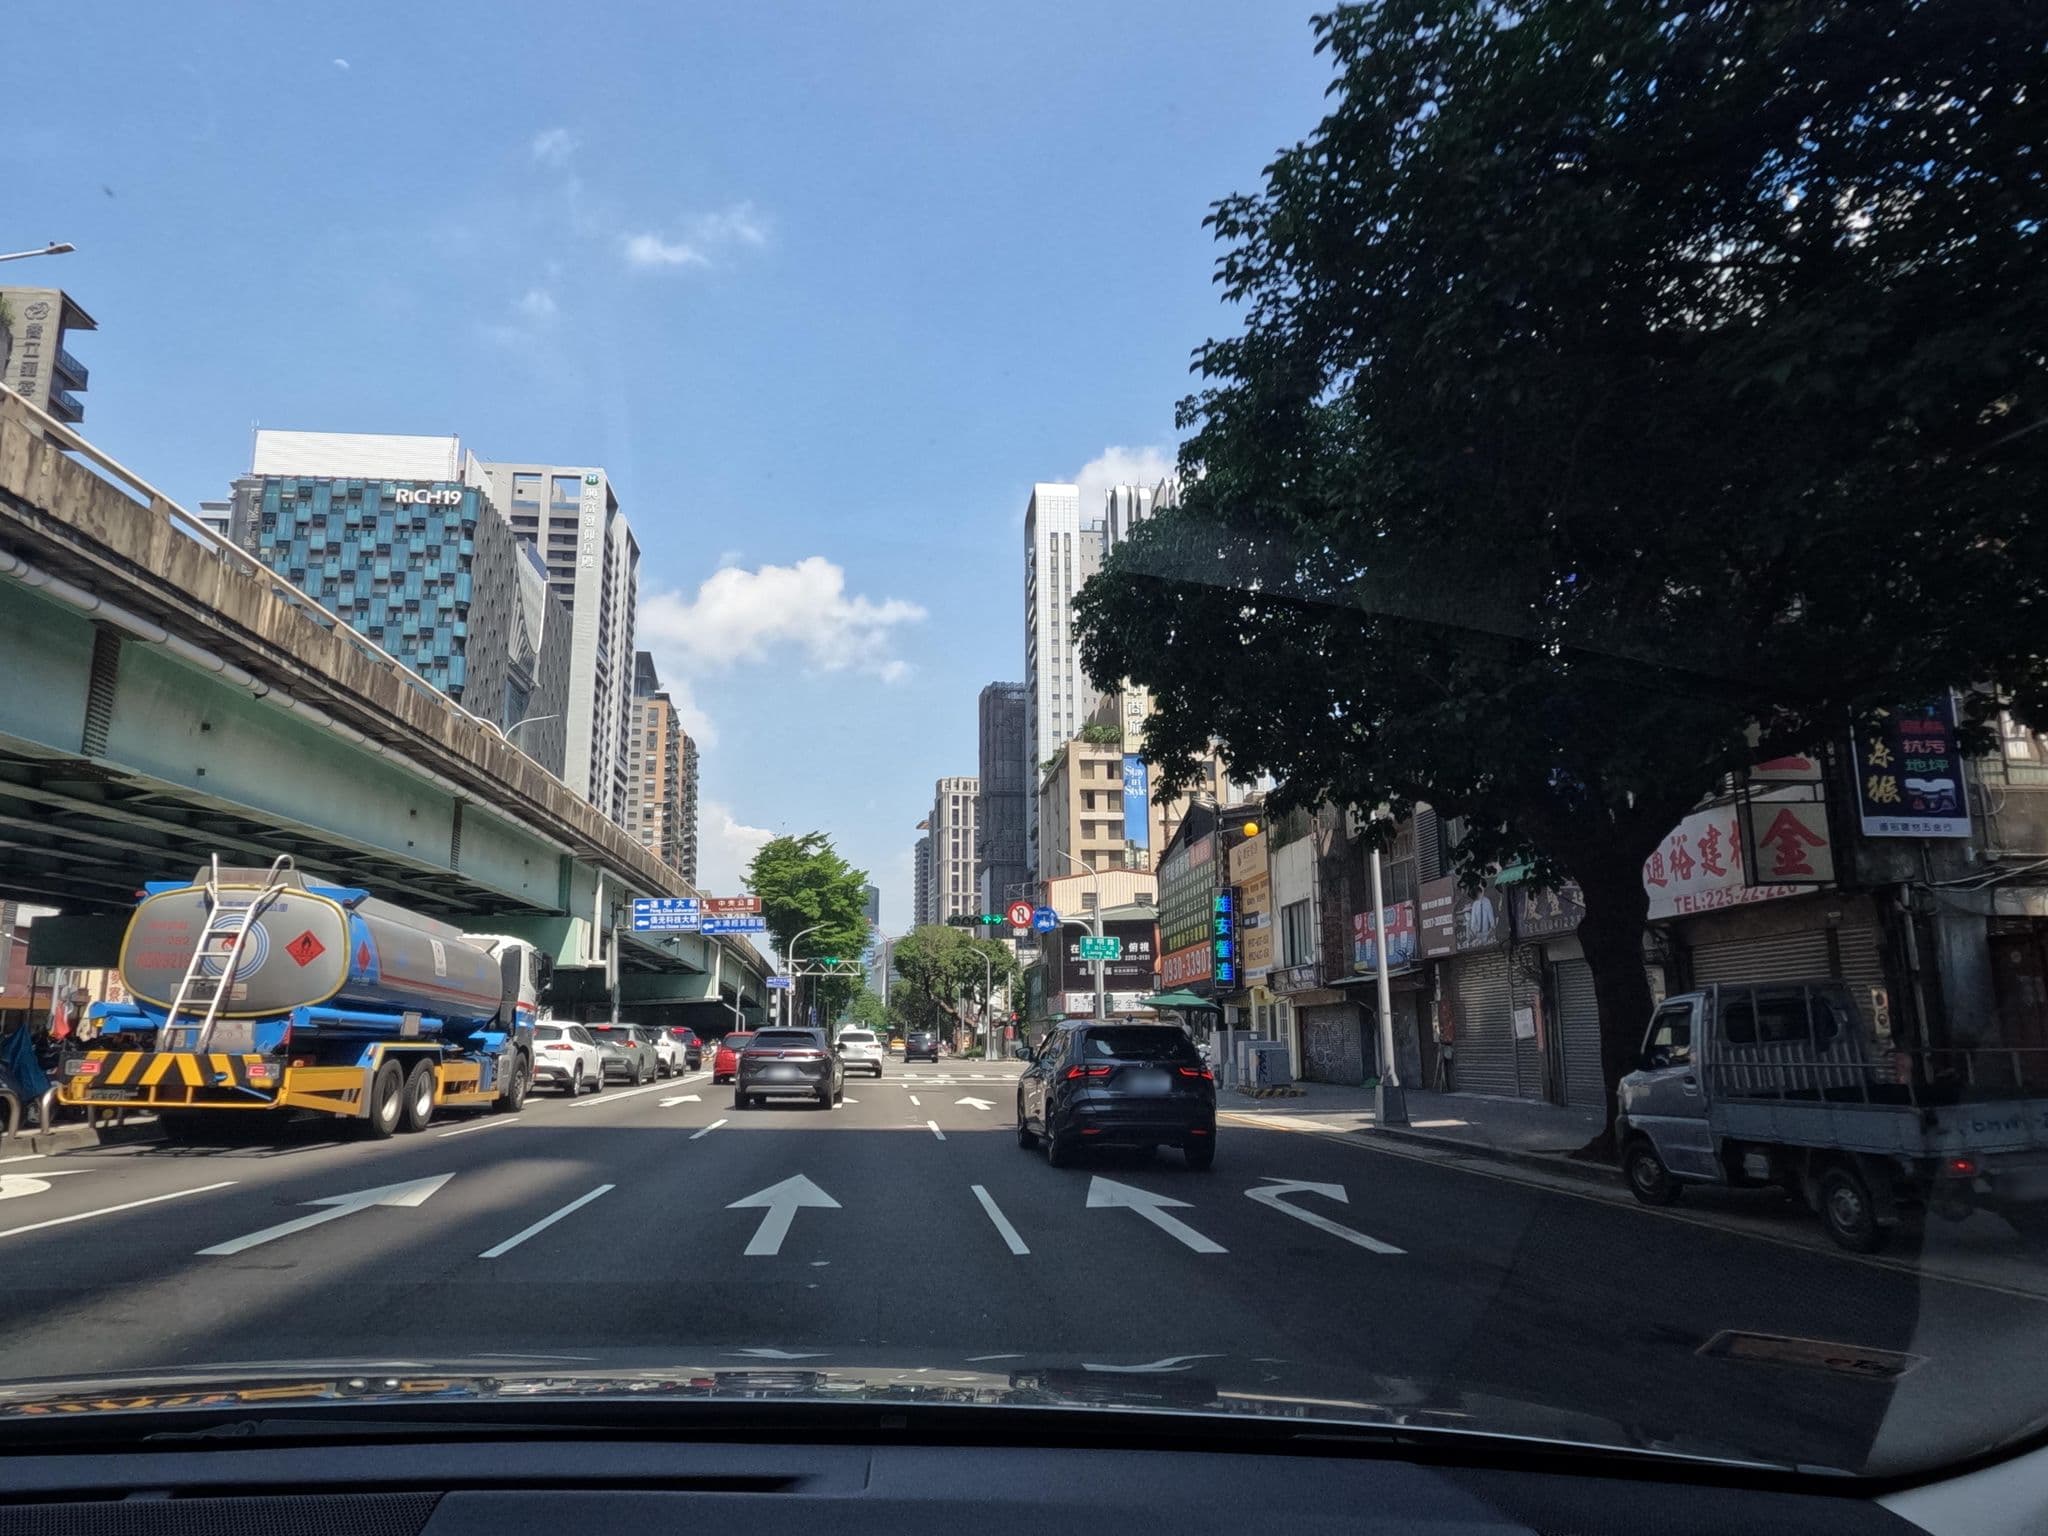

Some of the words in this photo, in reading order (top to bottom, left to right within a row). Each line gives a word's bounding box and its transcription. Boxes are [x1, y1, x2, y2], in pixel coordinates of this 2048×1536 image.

[1124, 766, 1144, 778] Stay
[1131, 777, 1141, 786] in
[1124, 786, 1147, 799] Style
[1759, 808, 1827, 876] 金
[650, 900, 697, 909] 逢甲大學
[1215, 895, 1233, 981] 雄安營造
